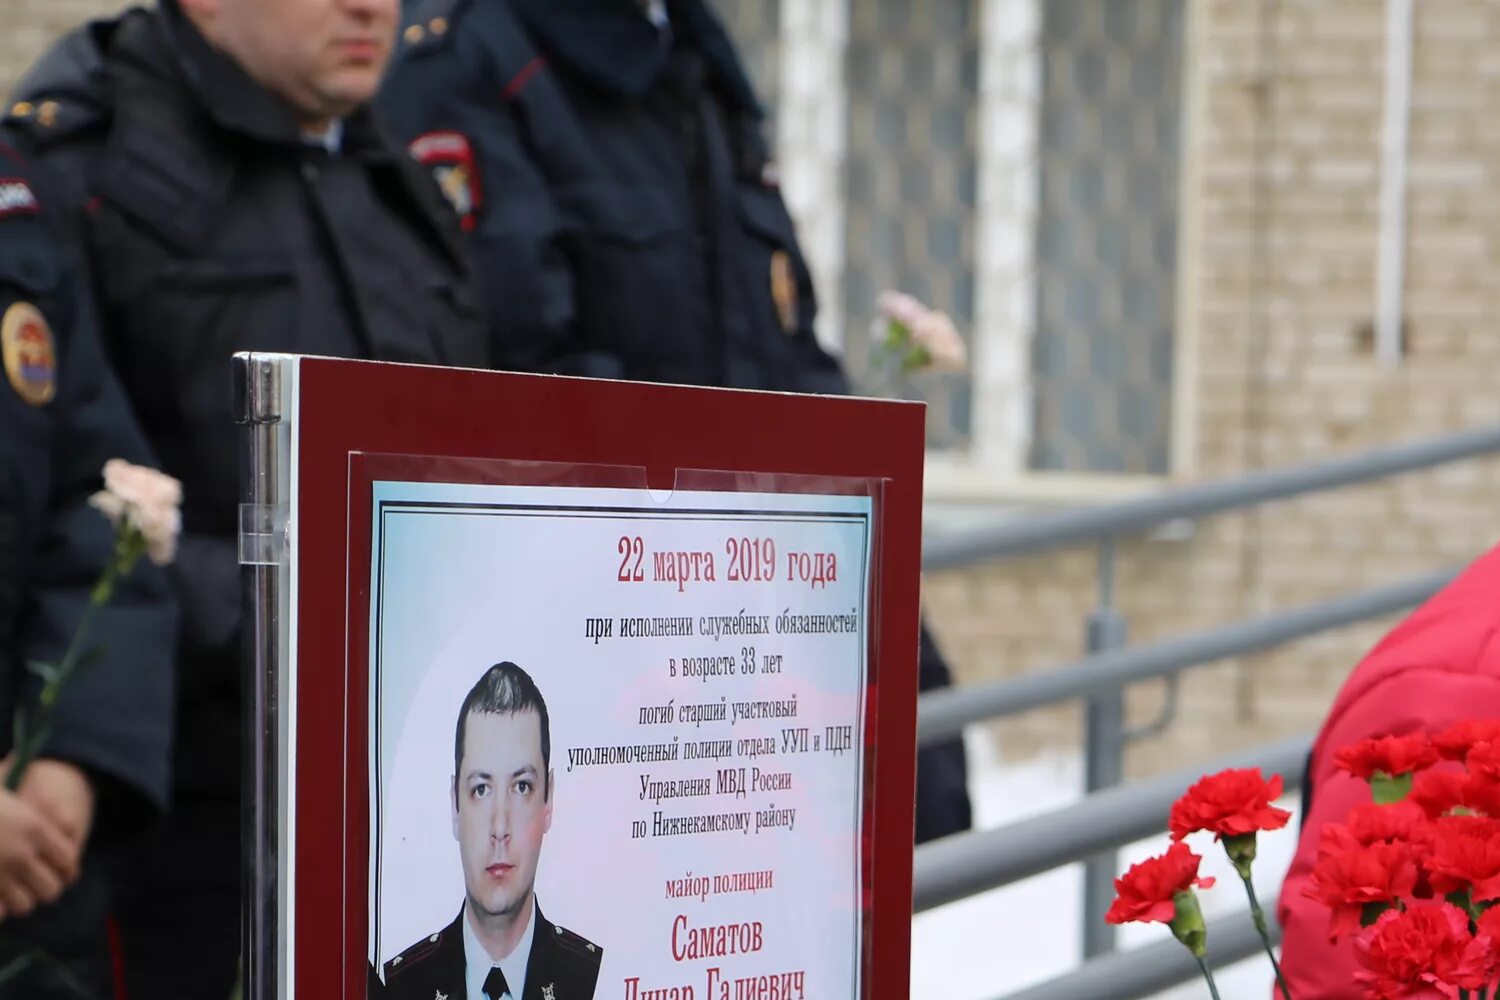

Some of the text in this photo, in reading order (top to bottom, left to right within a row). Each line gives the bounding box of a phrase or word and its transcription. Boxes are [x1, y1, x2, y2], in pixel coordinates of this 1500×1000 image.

[618, 536, 837, 593] 22 марта 2019 года
[585, 608, 857, 644] при исполнении служебных обязанностей
[670, 647, 782, 682] в возрасте 33 лет
[639, 694, 797, 727] погиб старший участковый
[567, 725, 852, 772] уполномоченный полиции отдела УУП и ПДН
[639, 767, 792, 805] Управления МВД России
[632, 803, 796, 839] по Нижнекамскому району
[665, 870, 773, 902] майор полиции
[671, 914, 763, 961] Саматов
